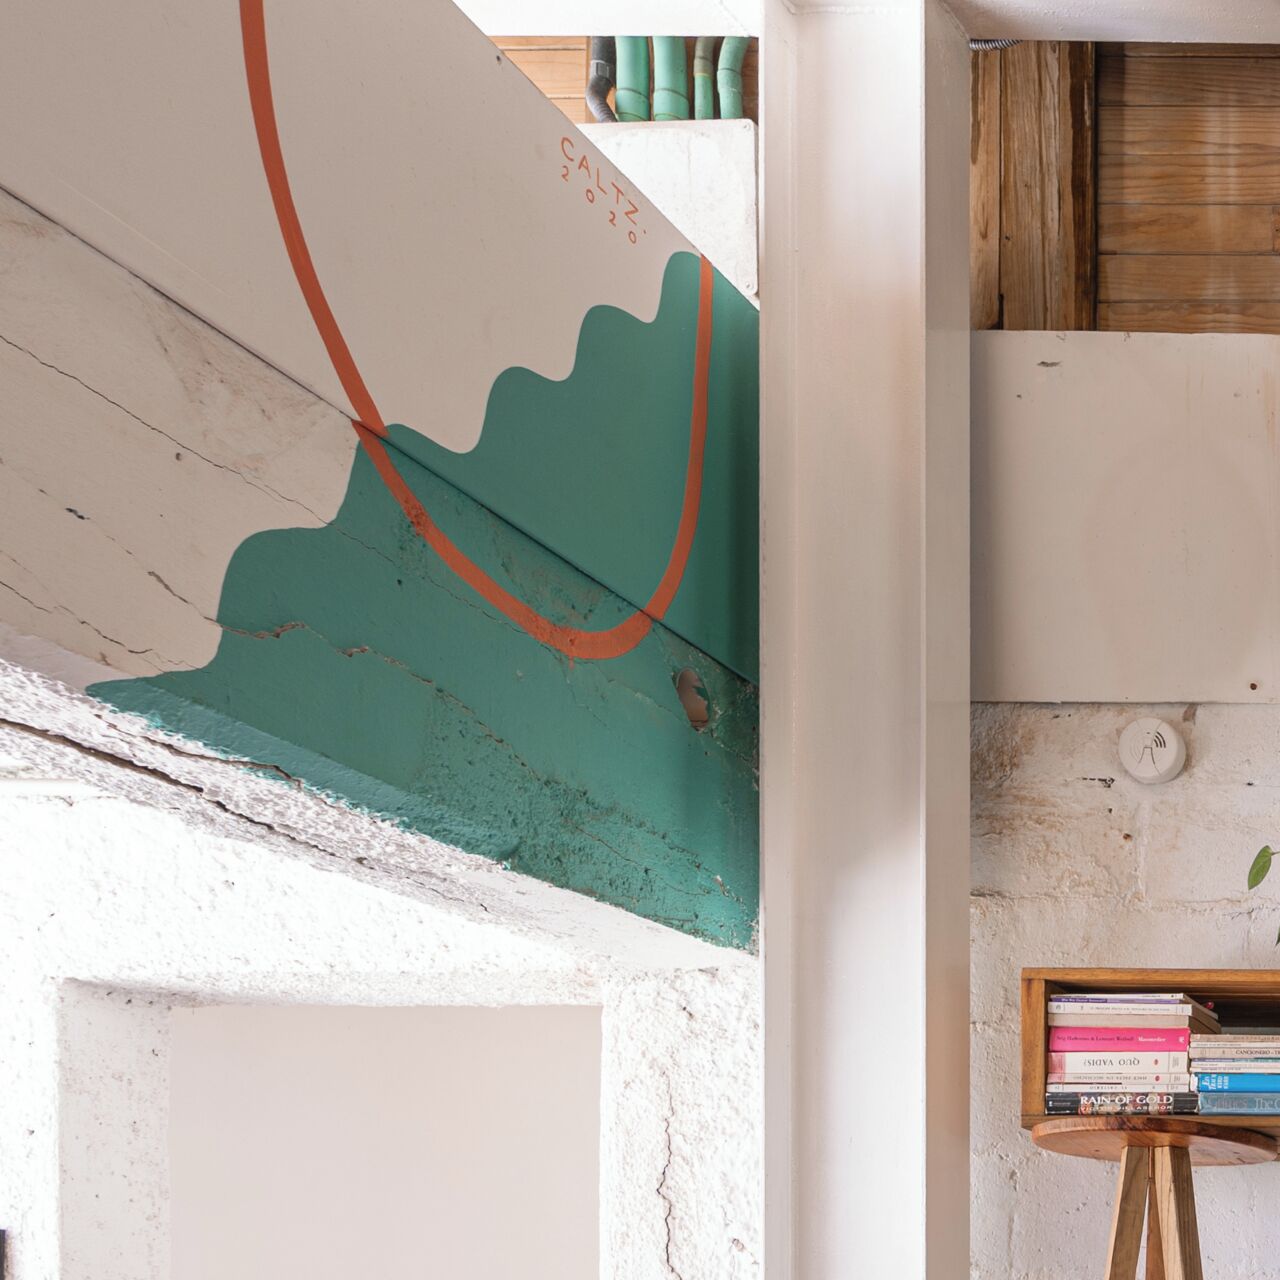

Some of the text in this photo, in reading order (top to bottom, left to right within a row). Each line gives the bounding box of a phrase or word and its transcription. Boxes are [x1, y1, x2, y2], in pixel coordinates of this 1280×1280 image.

[1084, 1058, 1140, 1066] QUO VADIS?
[1080, 1096, 1173, 1104] RAIN OF GOLD
[1254, 1098, 1273, 1110] The
